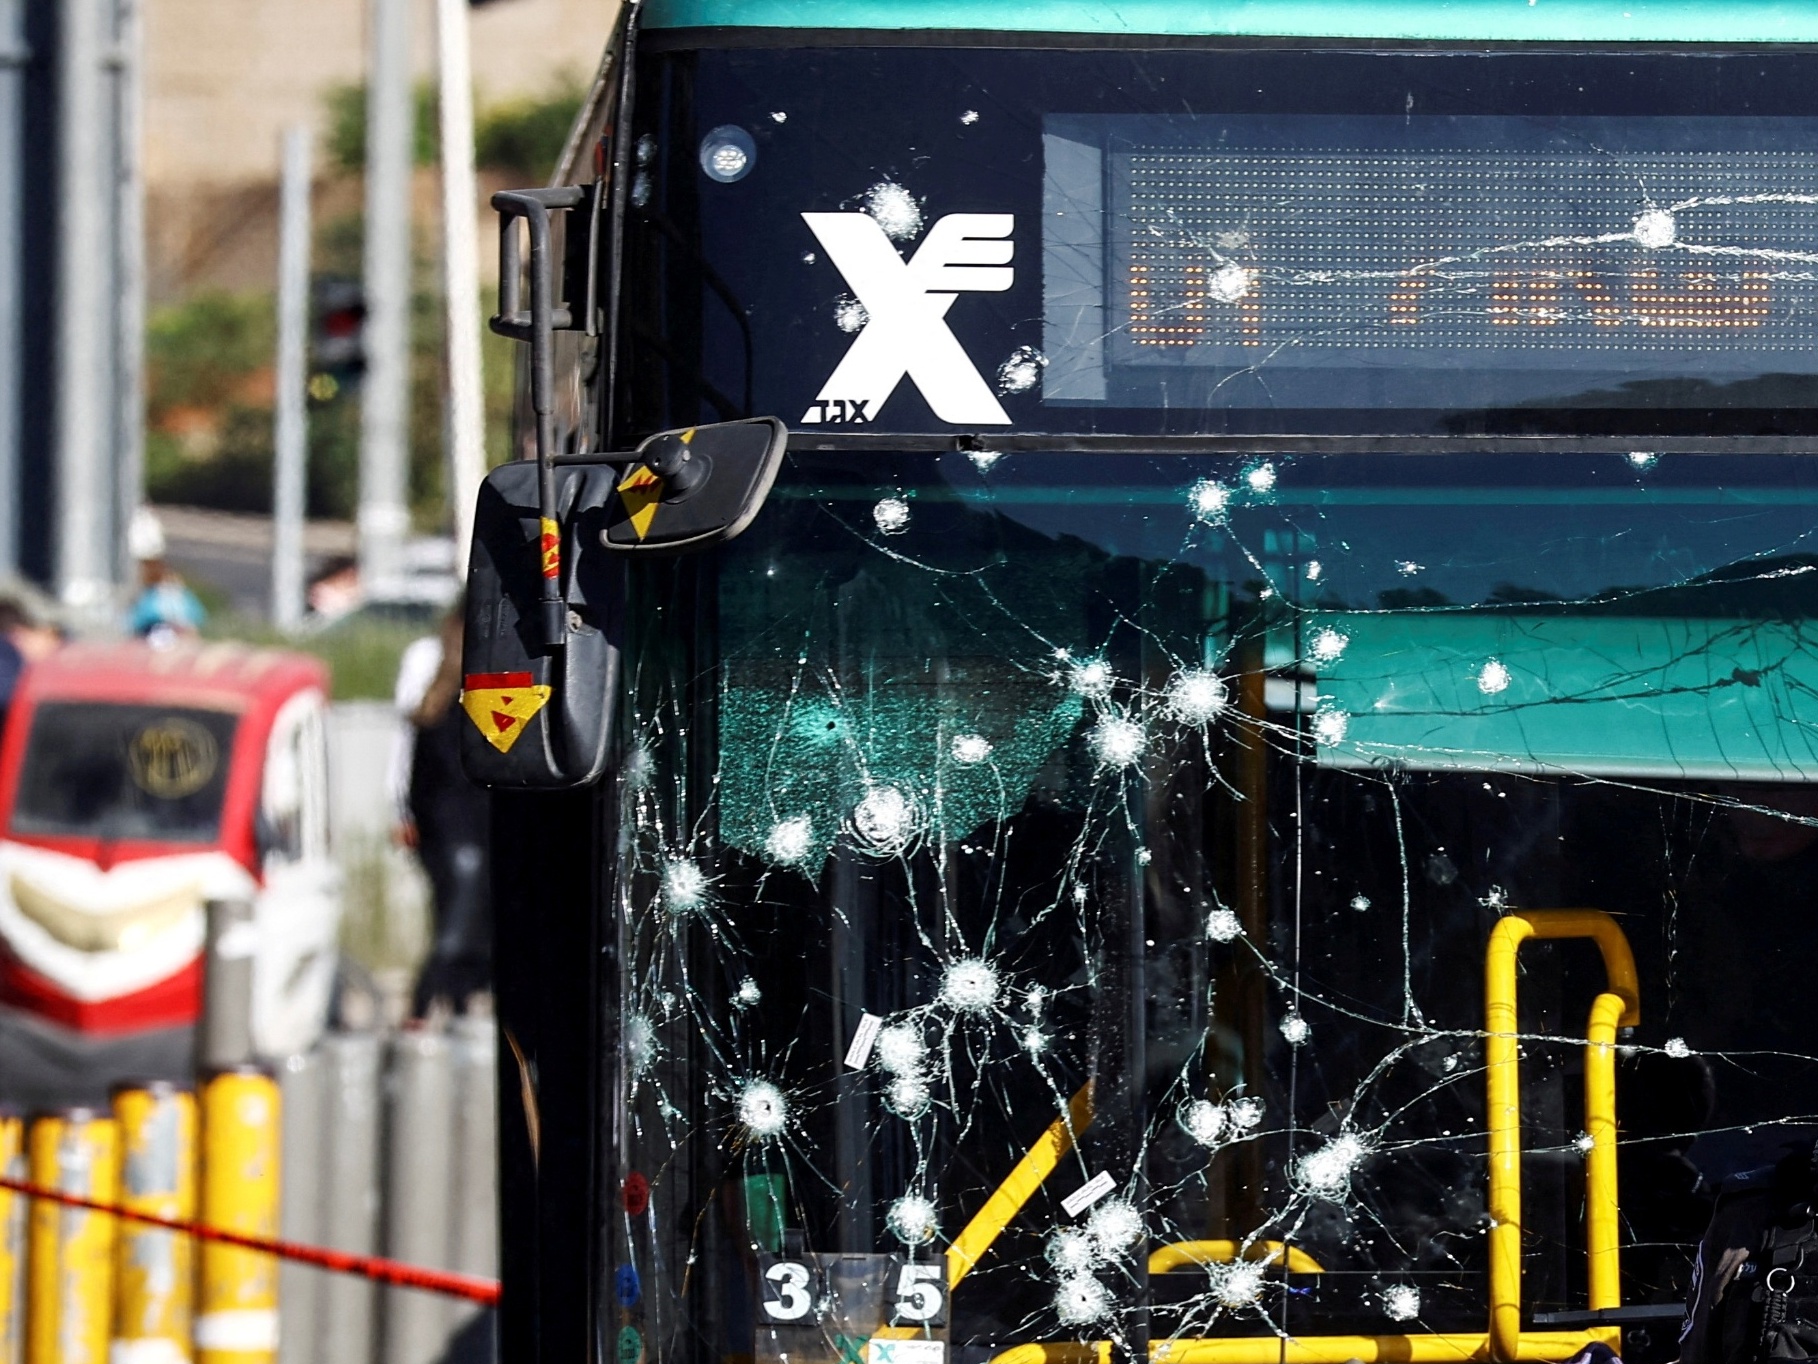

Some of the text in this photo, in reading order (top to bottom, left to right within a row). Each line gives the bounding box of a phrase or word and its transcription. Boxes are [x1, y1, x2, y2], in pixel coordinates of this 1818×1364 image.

[815, 400, 871, 424] אגד
[763, 1261, 944, 1321] 3 5
